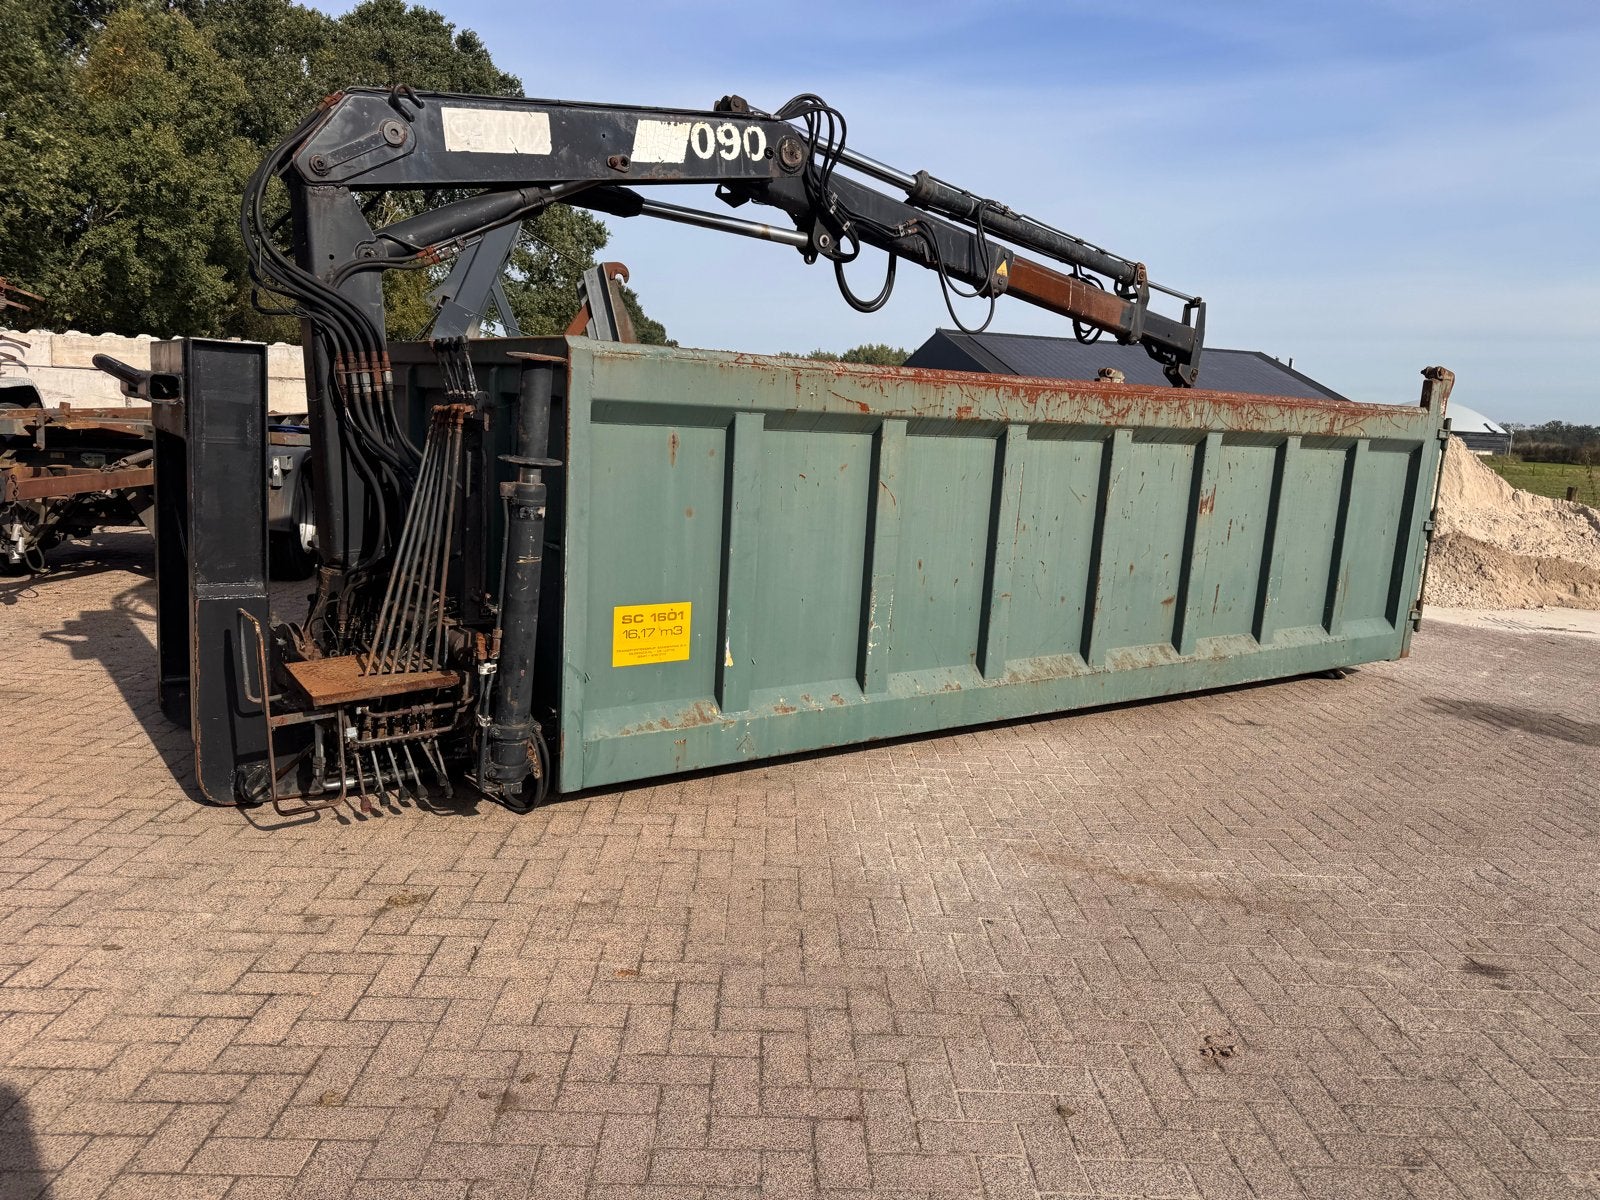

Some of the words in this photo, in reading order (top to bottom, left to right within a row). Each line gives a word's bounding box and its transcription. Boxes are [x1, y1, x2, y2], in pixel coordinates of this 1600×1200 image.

[691, 121, 767, 162] 090
[621, 614, 645, 624] SC
[650, 611, 684, 622] 1601
[659, 626, 683, 637] m3
